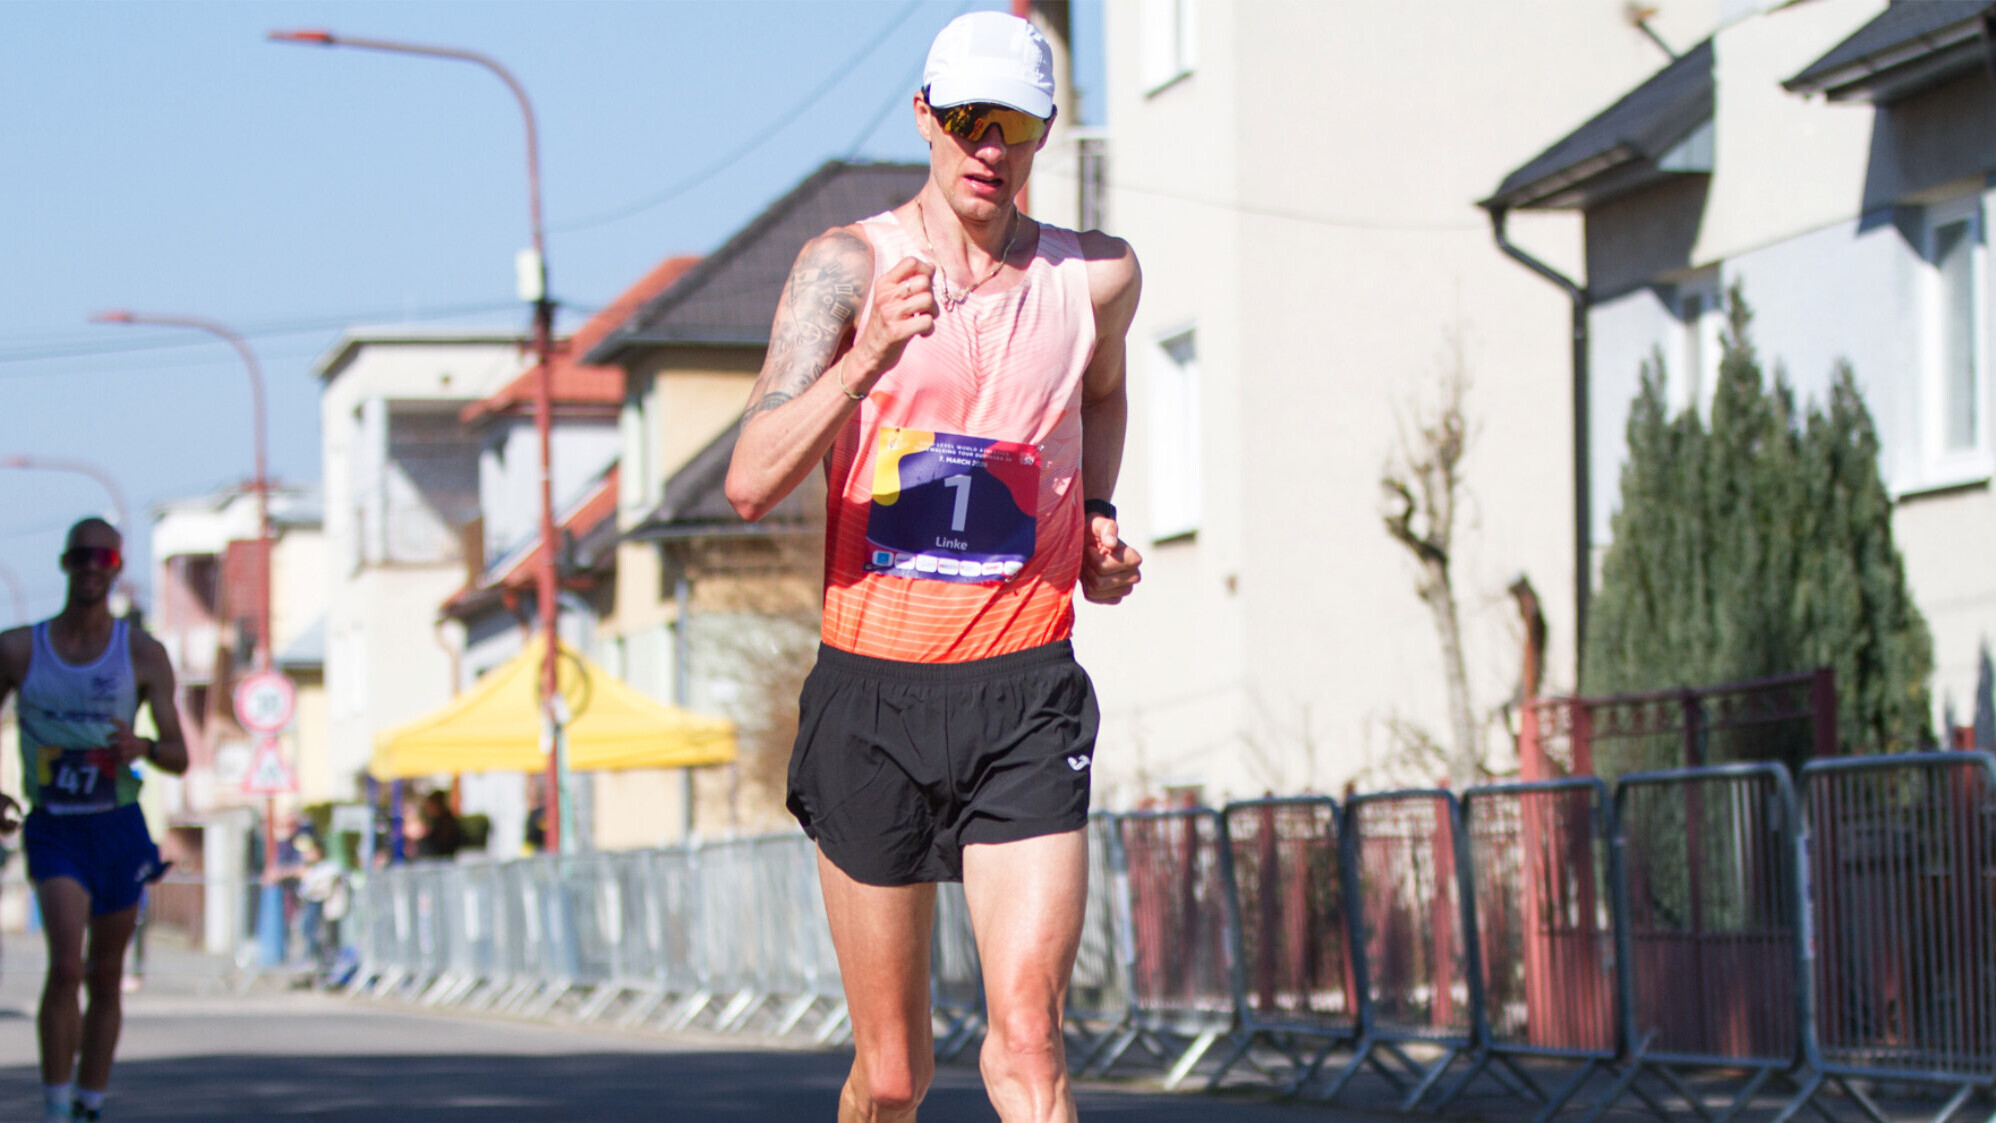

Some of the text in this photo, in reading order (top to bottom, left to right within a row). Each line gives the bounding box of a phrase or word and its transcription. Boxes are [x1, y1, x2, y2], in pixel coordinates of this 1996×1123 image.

[946, 457, 971, 466] MARCH
[944, 474, 972, 532] 1
[936, 536, 968, 550] Linke
[57, 765, 100, 795] 47
